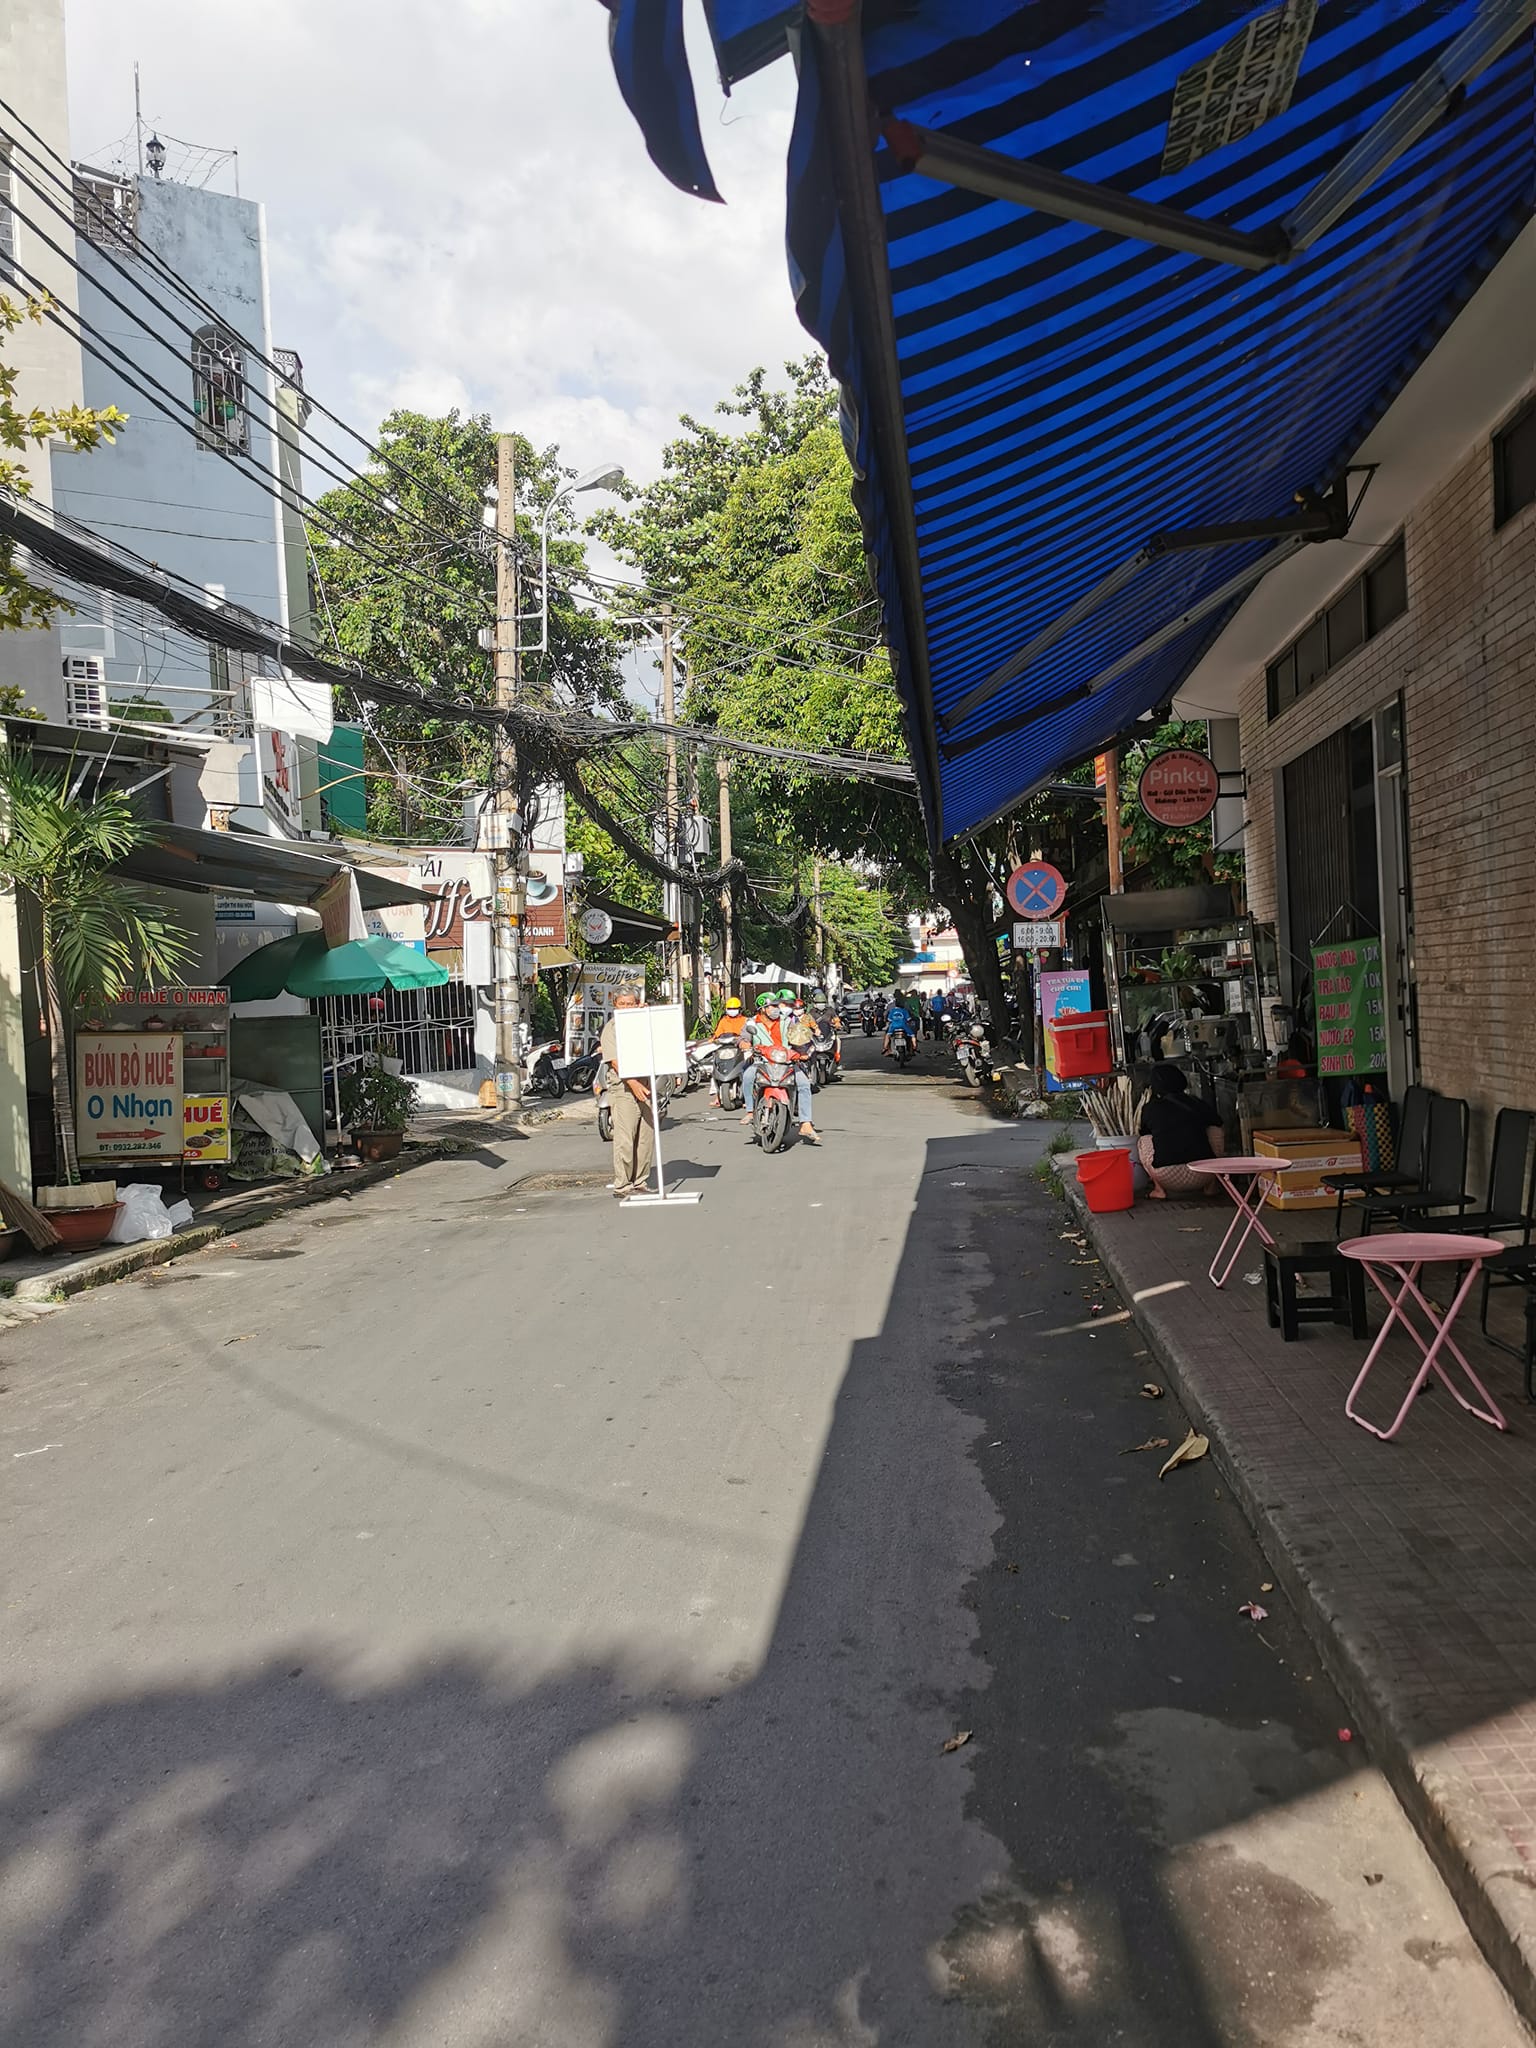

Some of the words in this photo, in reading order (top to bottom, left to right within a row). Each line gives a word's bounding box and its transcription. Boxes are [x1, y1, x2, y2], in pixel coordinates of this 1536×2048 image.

[1150, 767, 1209, 787] Pinky
[1363, 945, 1379, 961] 10K
[595, 970, 640, 985] Coffee
[1364, 972, 1381, 989] 10K
[139, 989, 168, 1005] HUẾ
[173, 991, 183, 1005] O
[188, 991, 226, 1006] NHẠN
[1319, 1004, 1336, 1021] RAU
[84, 1042, 116, 1087] BÚN
[120, 1042, 141, 1087] BÒ
[145, 1037, 175, 1086] HUẾ
[1321, 1055, 1341, 1072] SINH
[1370, 1052, 1387, 1068] 20K
[87, 1094, 104, 1119] O
[112, 1092, 172, 1125] Nhạn
[184, 1099, 222, 1123] HUẾ
